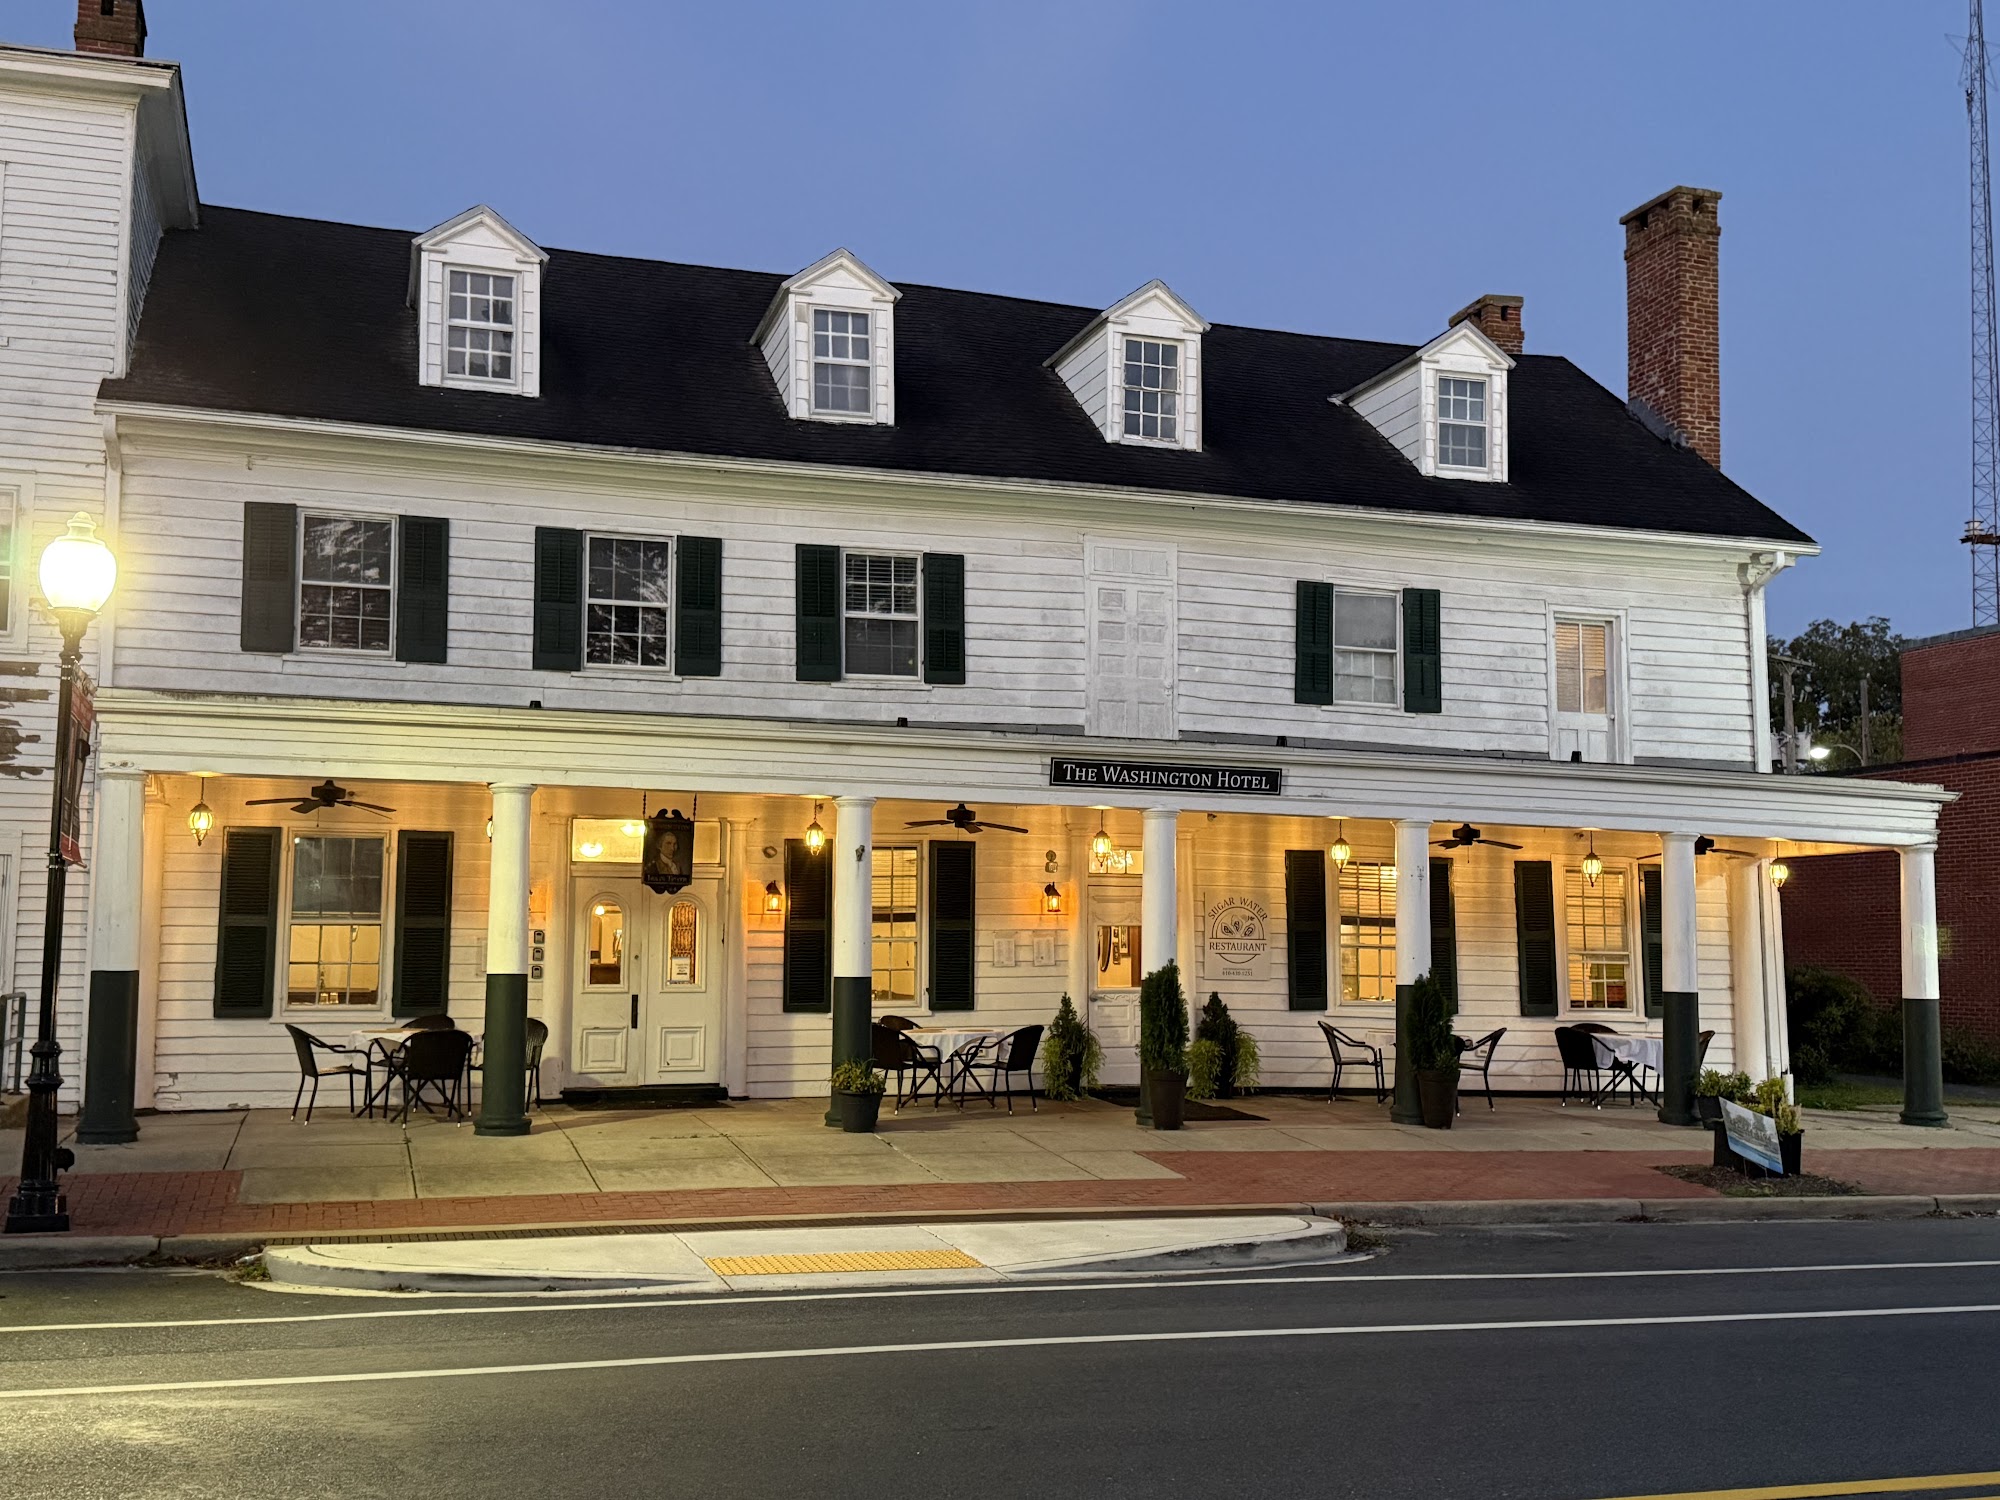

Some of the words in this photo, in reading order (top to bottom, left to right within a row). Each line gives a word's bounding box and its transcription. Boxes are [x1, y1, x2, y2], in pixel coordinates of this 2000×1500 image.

[1063, 764, 1097, 782] THE
[1102, 766, 1212, 787] WASHINGTON
[1217, 771, 1270, 789] HOTEL
[1208, 897, 1235, 920] SUGAR
[1240, 896, 1268, 921] WATER
[1209, 941, 1267, 952] RESTAURANT
